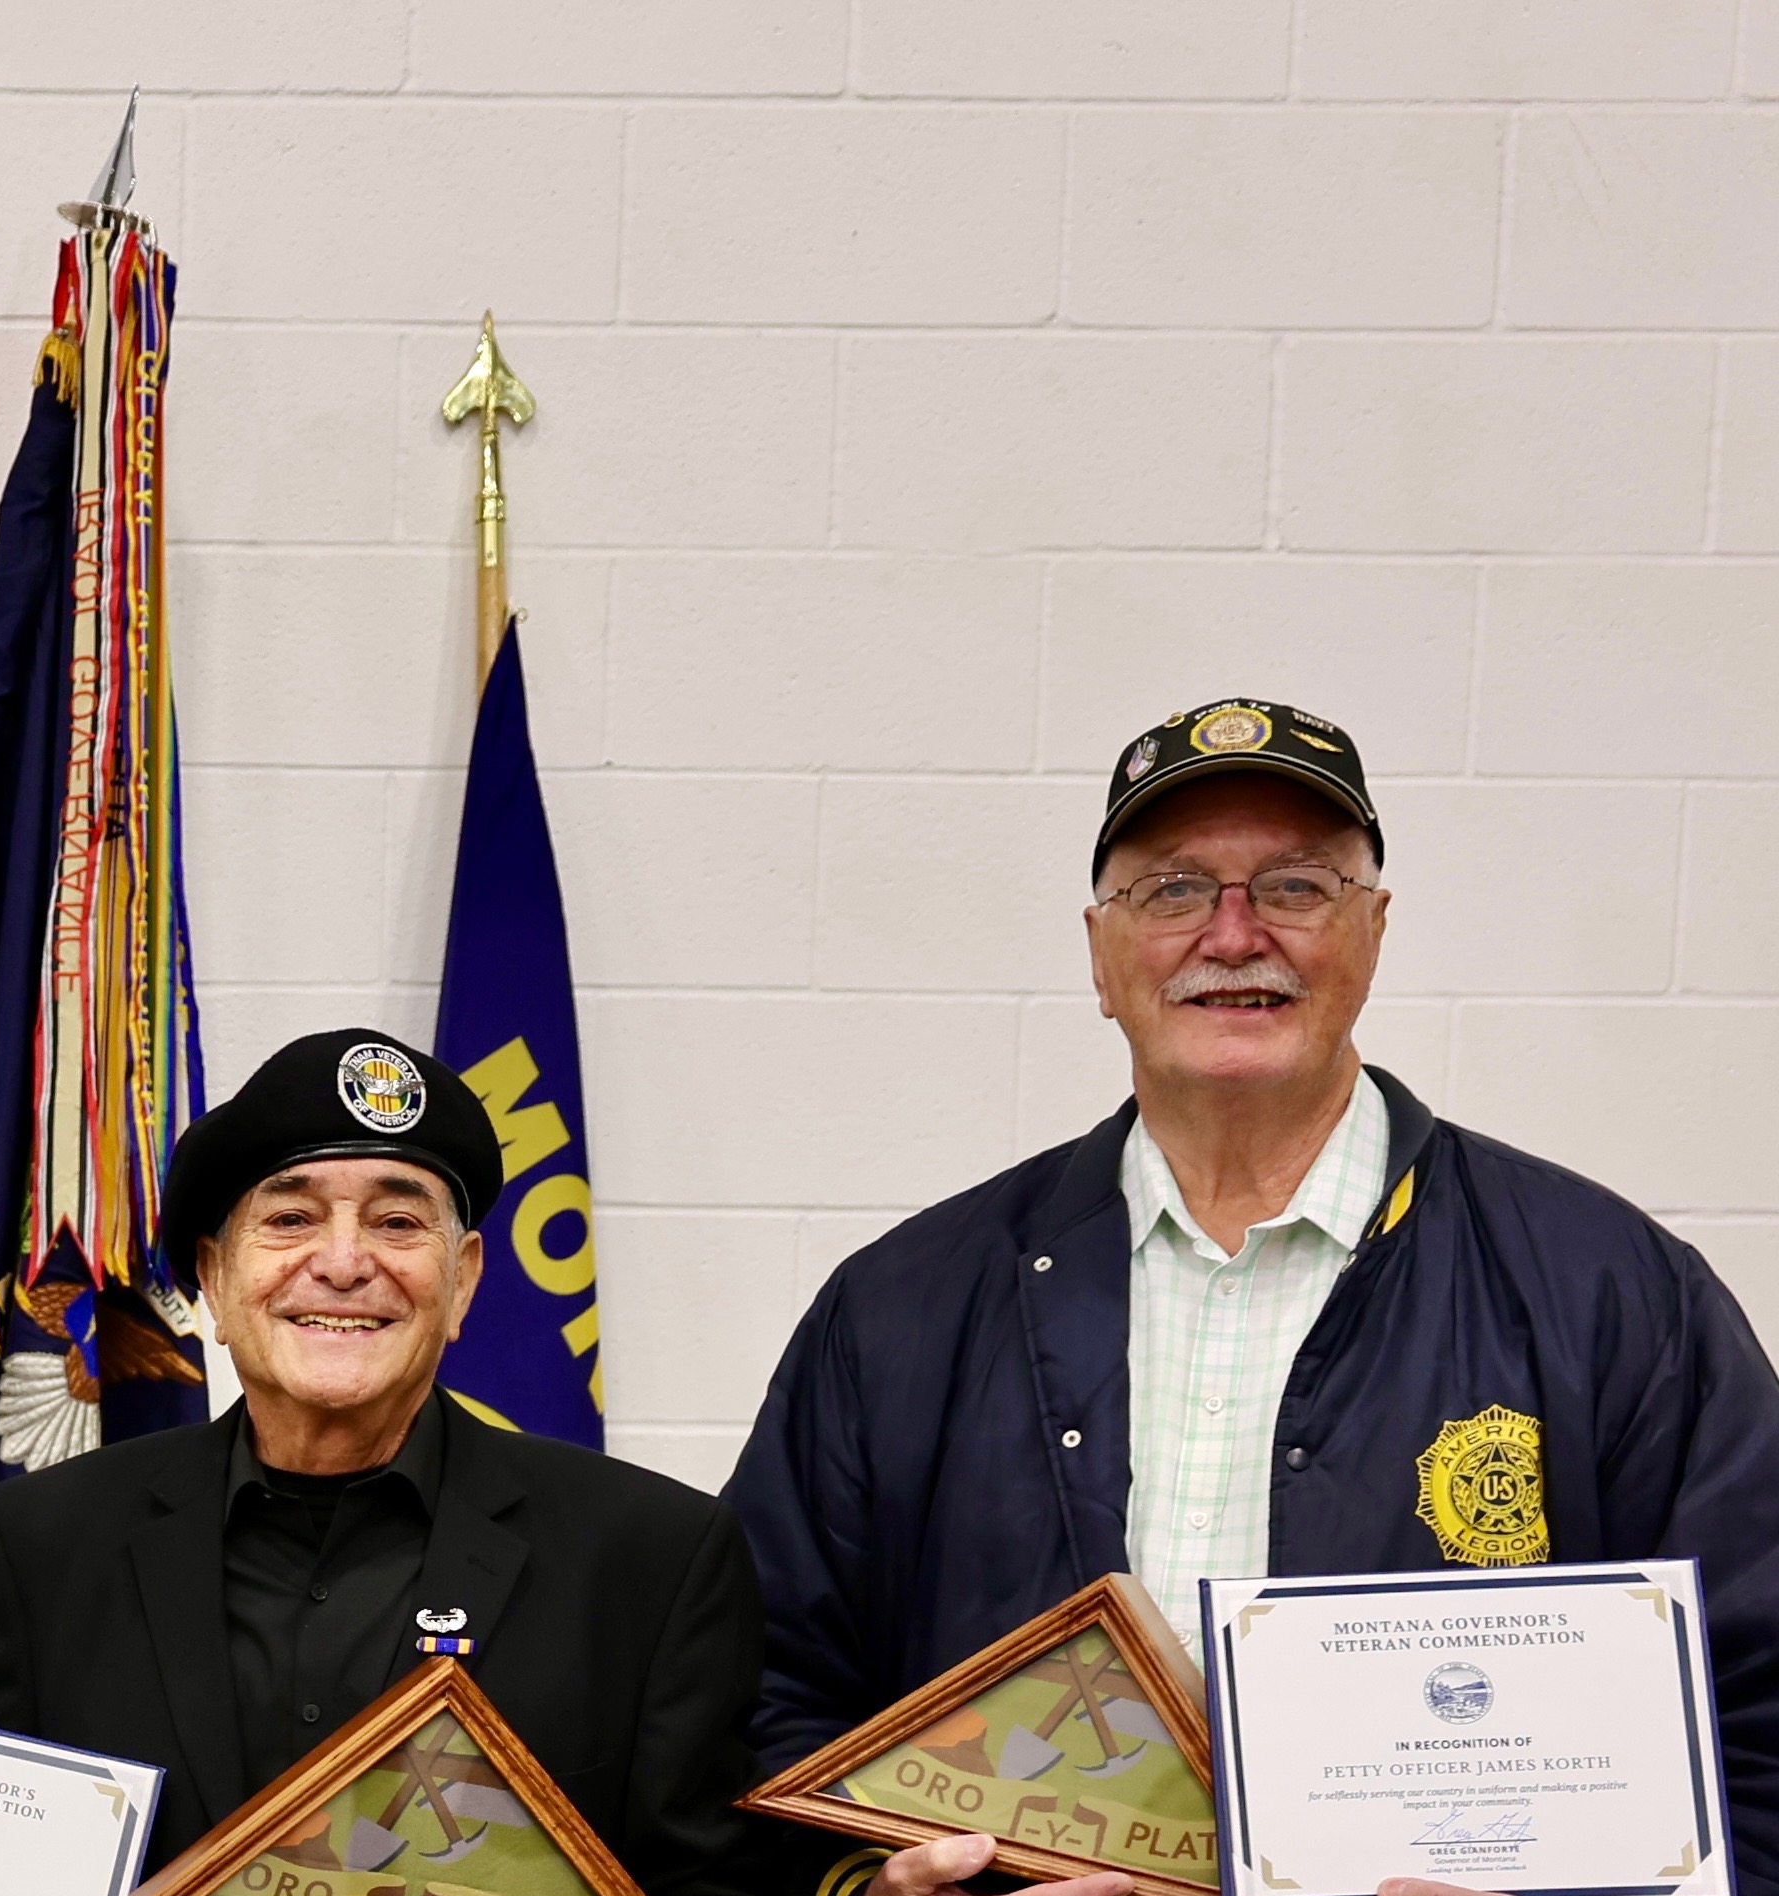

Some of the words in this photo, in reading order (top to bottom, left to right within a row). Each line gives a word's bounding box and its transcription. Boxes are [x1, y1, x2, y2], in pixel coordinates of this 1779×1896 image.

[1456, 1529, 1540, 1553] LEGION
[1333, 1619, 1434, 1635] MONTANA
[1441, 1613, 1567, 1630] GOVERNOR'S
[1319, 1637, 1410, 1653] VETERAN
[1418, 1630, 1584, 1649] COMMENDATION
[1395, 1741, 1410, 1751] IN
[1414, 1737, 1509, 1750] RECOGNITION
[1514, 1736, 1532, 1746] OF
[1323, 1764, 1383, 1778] PETTY
[1389, 1761, 1472, 1776] OFFICER
[1475, 1758, 1536, 1776] JAMES
[1542, 1756, 1611, 1770] KORTH
[897, 1759, 984, 1813] ORO
[1307, 1791, 1323, 1802] for
[1324, 1789, 1368, 1801] selflessly
[1369, 1788, 1405, 1800] serving
[1406, 1789, 1424, 1797] our
[1425, 1787, 1464, 1797] country
[1465, 1785, 1476, 1795] in
[1477, 1784, 1517, 1795] uniform
[1519, 1782, 1539, 1793] and
[1540, 1782, 1578, 1793] making
[1579, 1783, 1587, 1791] a
[1588, 1780, 1628, 1792] positive
[1402, 1800, 1437, 1811] impact
[1438, 1798, 1449, 1808] in
[1451, 1799, 1474, 1810] your
[1475, 1796, 1533, 1807] community.
[1428, 1847, 1456, 1856] GREG
